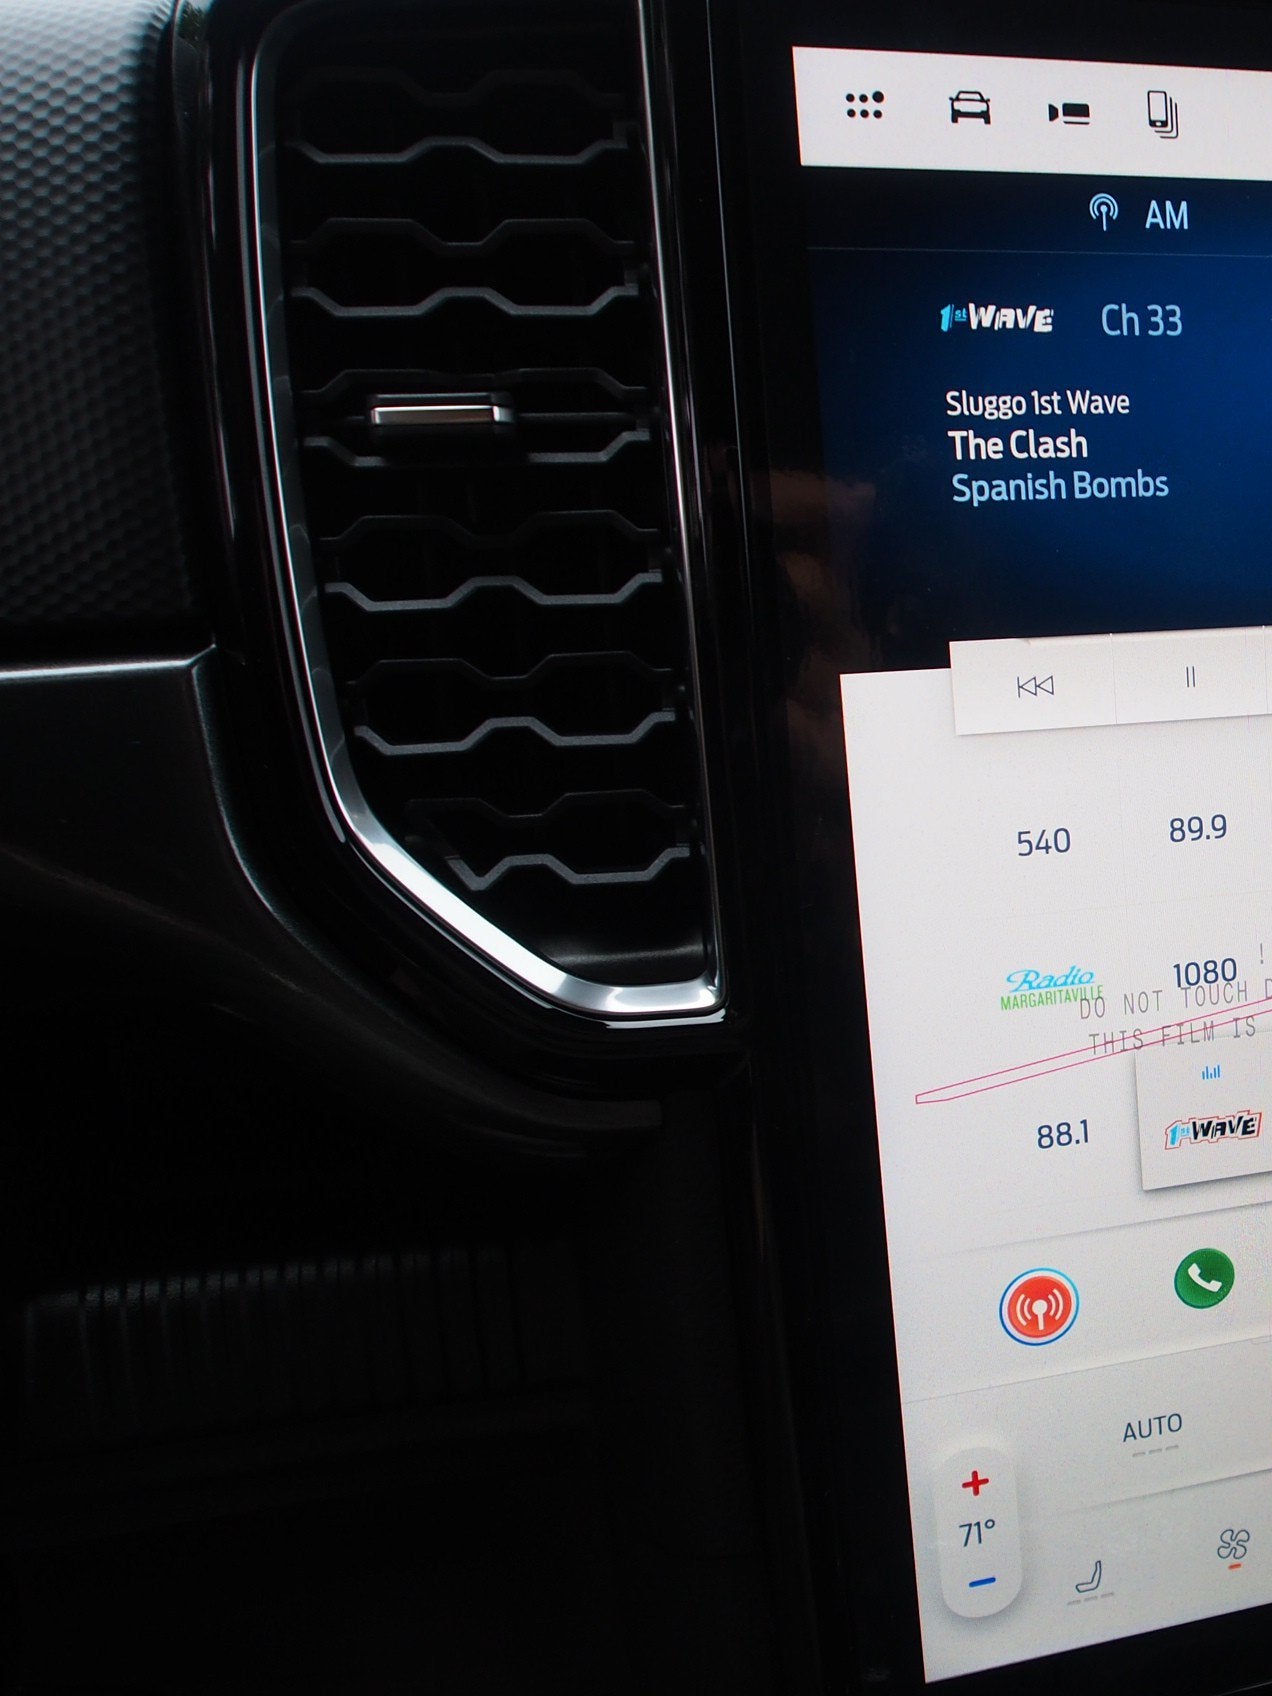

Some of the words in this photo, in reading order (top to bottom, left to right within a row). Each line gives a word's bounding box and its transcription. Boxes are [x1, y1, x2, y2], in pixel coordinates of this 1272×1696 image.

[1145, 200, 1188, 230] AM
[1101, 304, 1140, 336] Ch
[1148, 305, 1183, 336] 33
[946, 390, 1027, 420] Sluggo
[1031, 390, 1062, 415] 1st
[1066, 389, 1130, 415] Wave
[947, 429, 1004, 460] The
[1009, 428, 1088, 459] Clash
[952, 470, 1067, 507] Spanish
[1073, 469, 1169, 499] Bombs
[1016, 827, 1072, 857] 540
[1169, 813, 1227, 843] 89.9
[1006, 964, 1095, 993] Radio
[1173, 957, 1237, 988] 1080
[1000, 985, 1104, 1011] MARGARITAVILLE
[1080, 996, 1105, 1020] DO
[1124, 990, 1163, 1015] NOT
[1181, 981, 1247, 1008] TOUCH
[1089, 1028, 1144, 1055] THIS
[1162, 1021, 1214, 1047] FILM
[1233, 1016, 1256, 1038] IS
[1037, 1119, 1089, 1149] 88.1
[1122, 1413, 1183, 1443] AUTO
